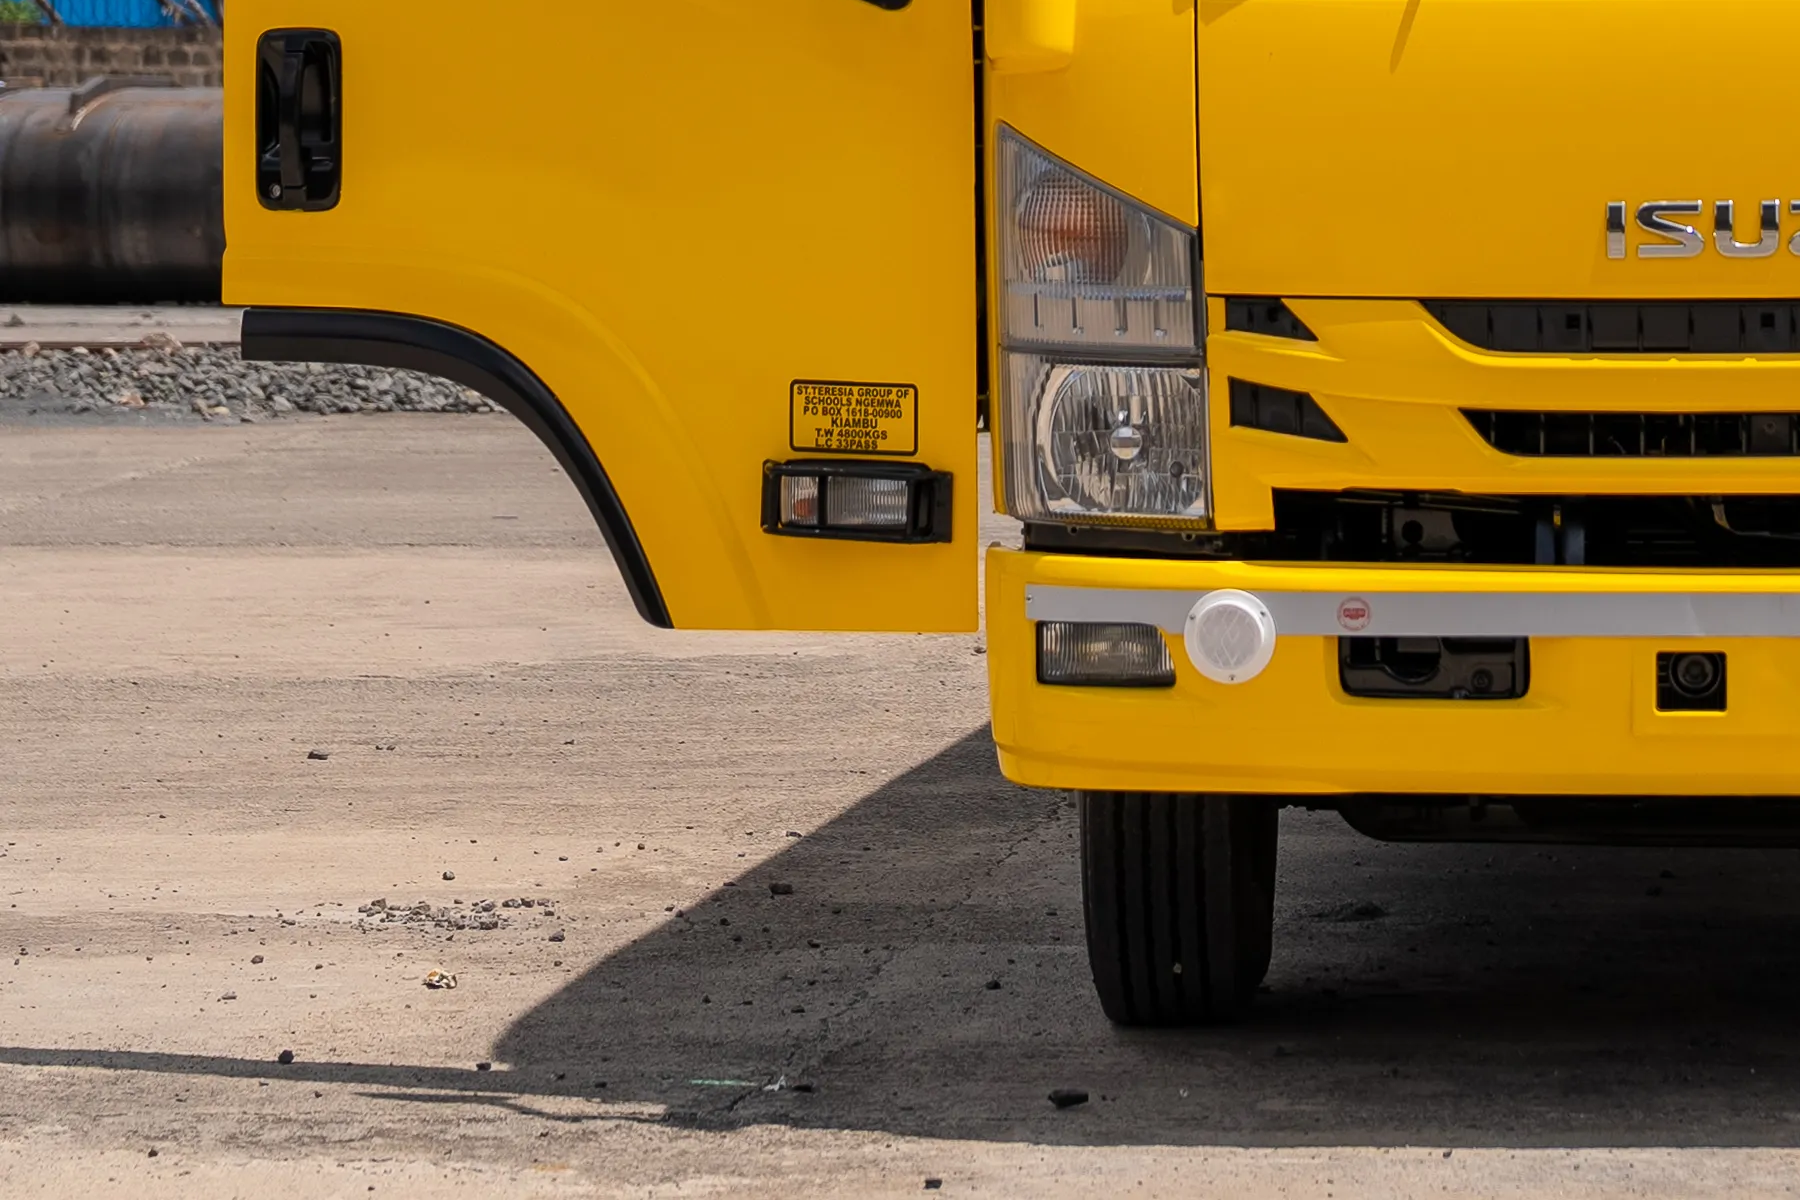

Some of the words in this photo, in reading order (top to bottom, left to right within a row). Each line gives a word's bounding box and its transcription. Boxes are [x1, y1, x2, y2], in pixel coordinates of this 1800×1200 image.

[857, 387, 893, 398] GROUP
[896, 389, 909, 399] OF
[804, 396, 852, 406] SCHOOLS
[855, 398, 902, 409] NGEMWA
[822, 406, 842, 417] BOX
[831, 417, 878, 429] KIAMBU
[815, 428, 834, 438] T.W
[837, 428, 888, 440] 4800KGS
[815, 438, 833, 448] L.C
[836, 438, 878, 450] 33PASS
